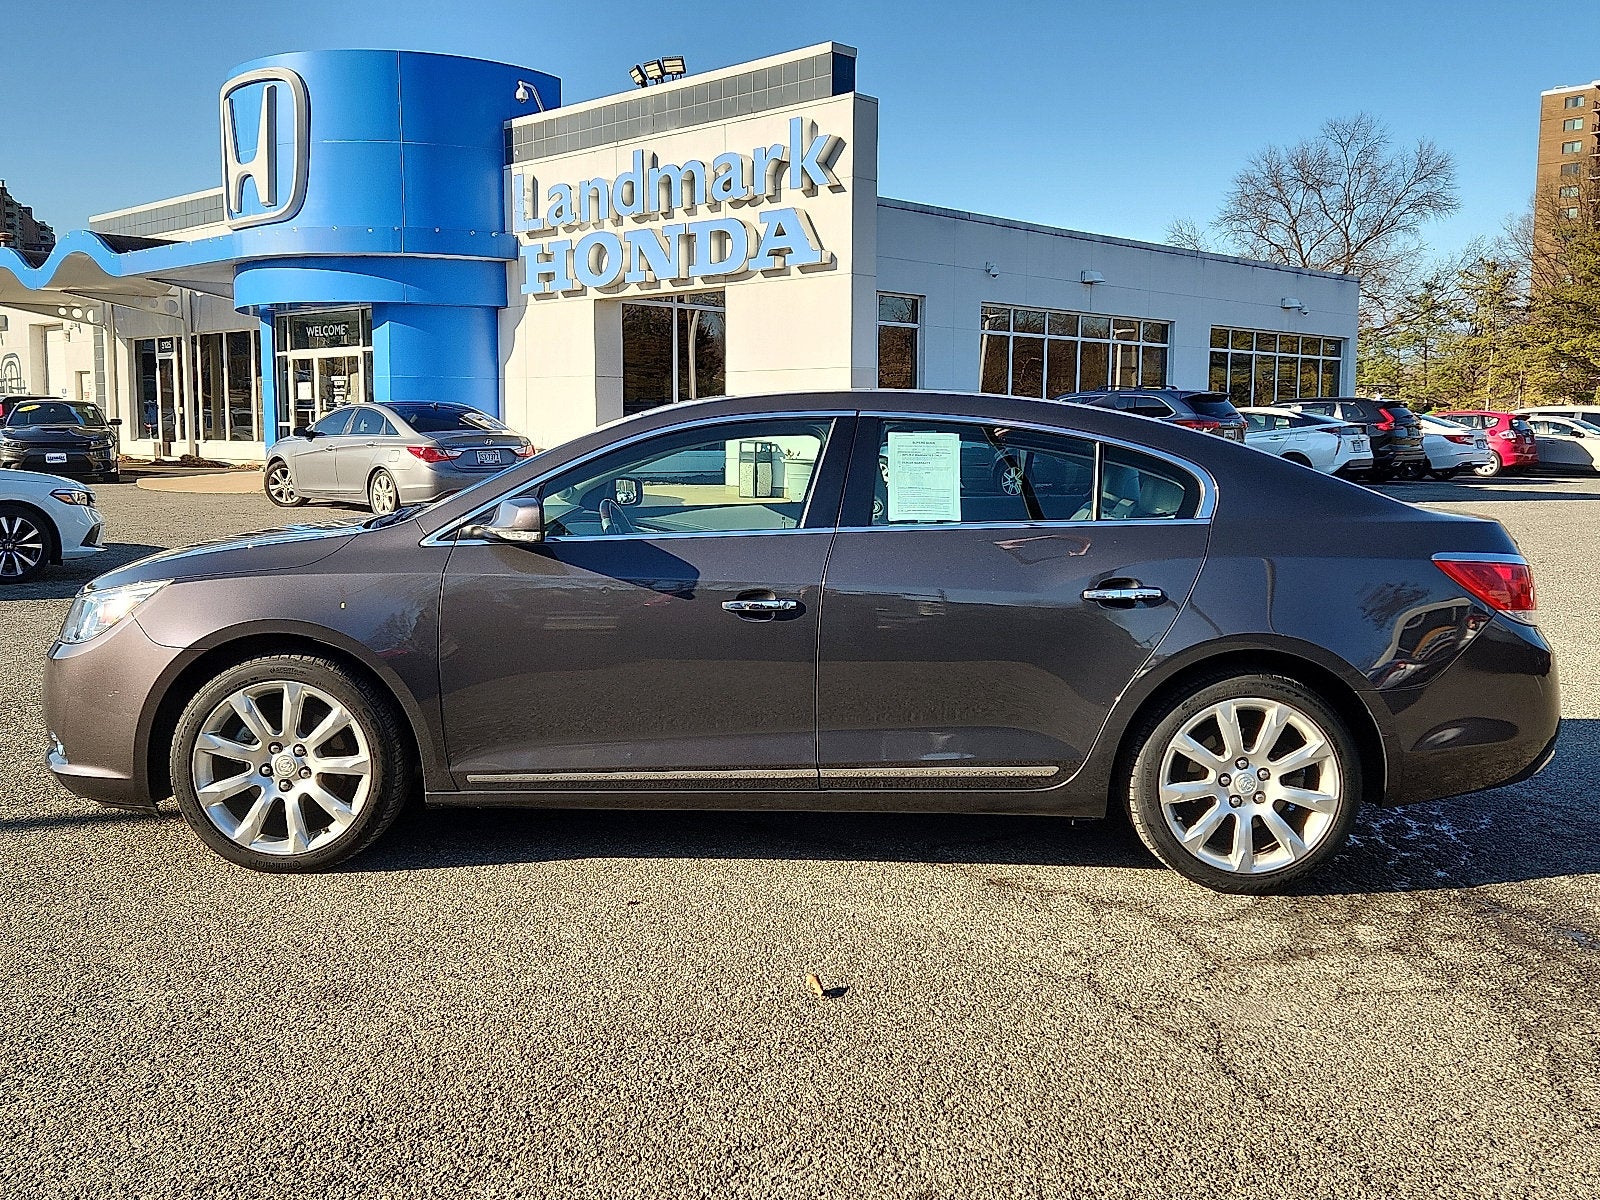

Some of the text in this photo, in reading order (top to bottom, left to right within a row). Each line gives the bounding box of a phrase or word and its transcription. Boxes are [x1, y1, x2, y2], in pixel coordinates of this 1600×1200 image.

[513, 116, 845, 238] Landmark
[519, 206, 834, 299] HONDA
[305, 323, 346, 337] WELCOME
